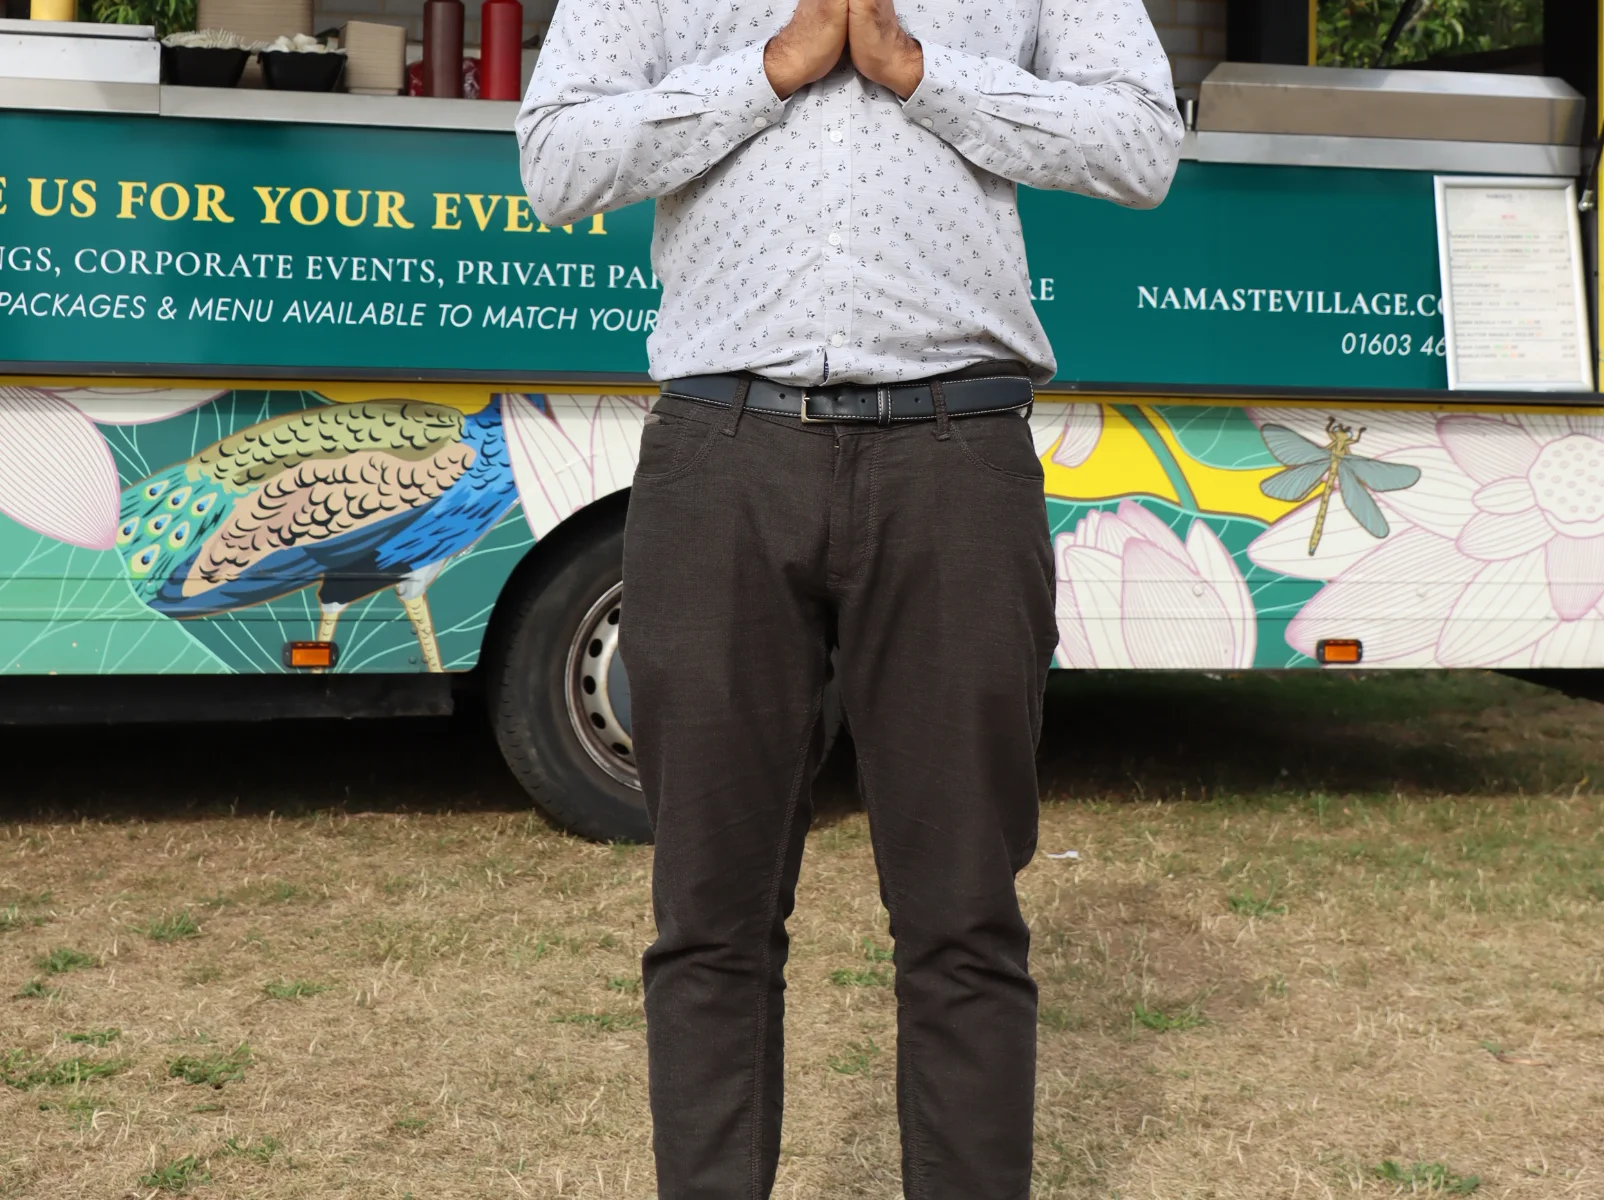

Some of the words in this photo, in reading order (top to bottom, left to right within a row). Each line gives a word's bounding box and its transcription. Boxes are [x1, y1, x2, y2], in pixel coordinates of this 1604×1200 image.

[27, 177, 98, 218] US
[115, 180, 235, 224] FOR
[253, 186, 416, 230] YOUR
[74, 248, 294, 280] CORPORATE
[307, 255, 445, 288] EVENTS,
[457, 260, 596, 288] PRIVATE
[157, 295, 178, 320] &
[188, 297, 274, 323] MENU
[282, 299, 427, 327] AVAILABLE
[438, 303, 473, 328] TO
[482, 305, 578, 330] MATCH
[1341, 332, 1412, 356] 01603
